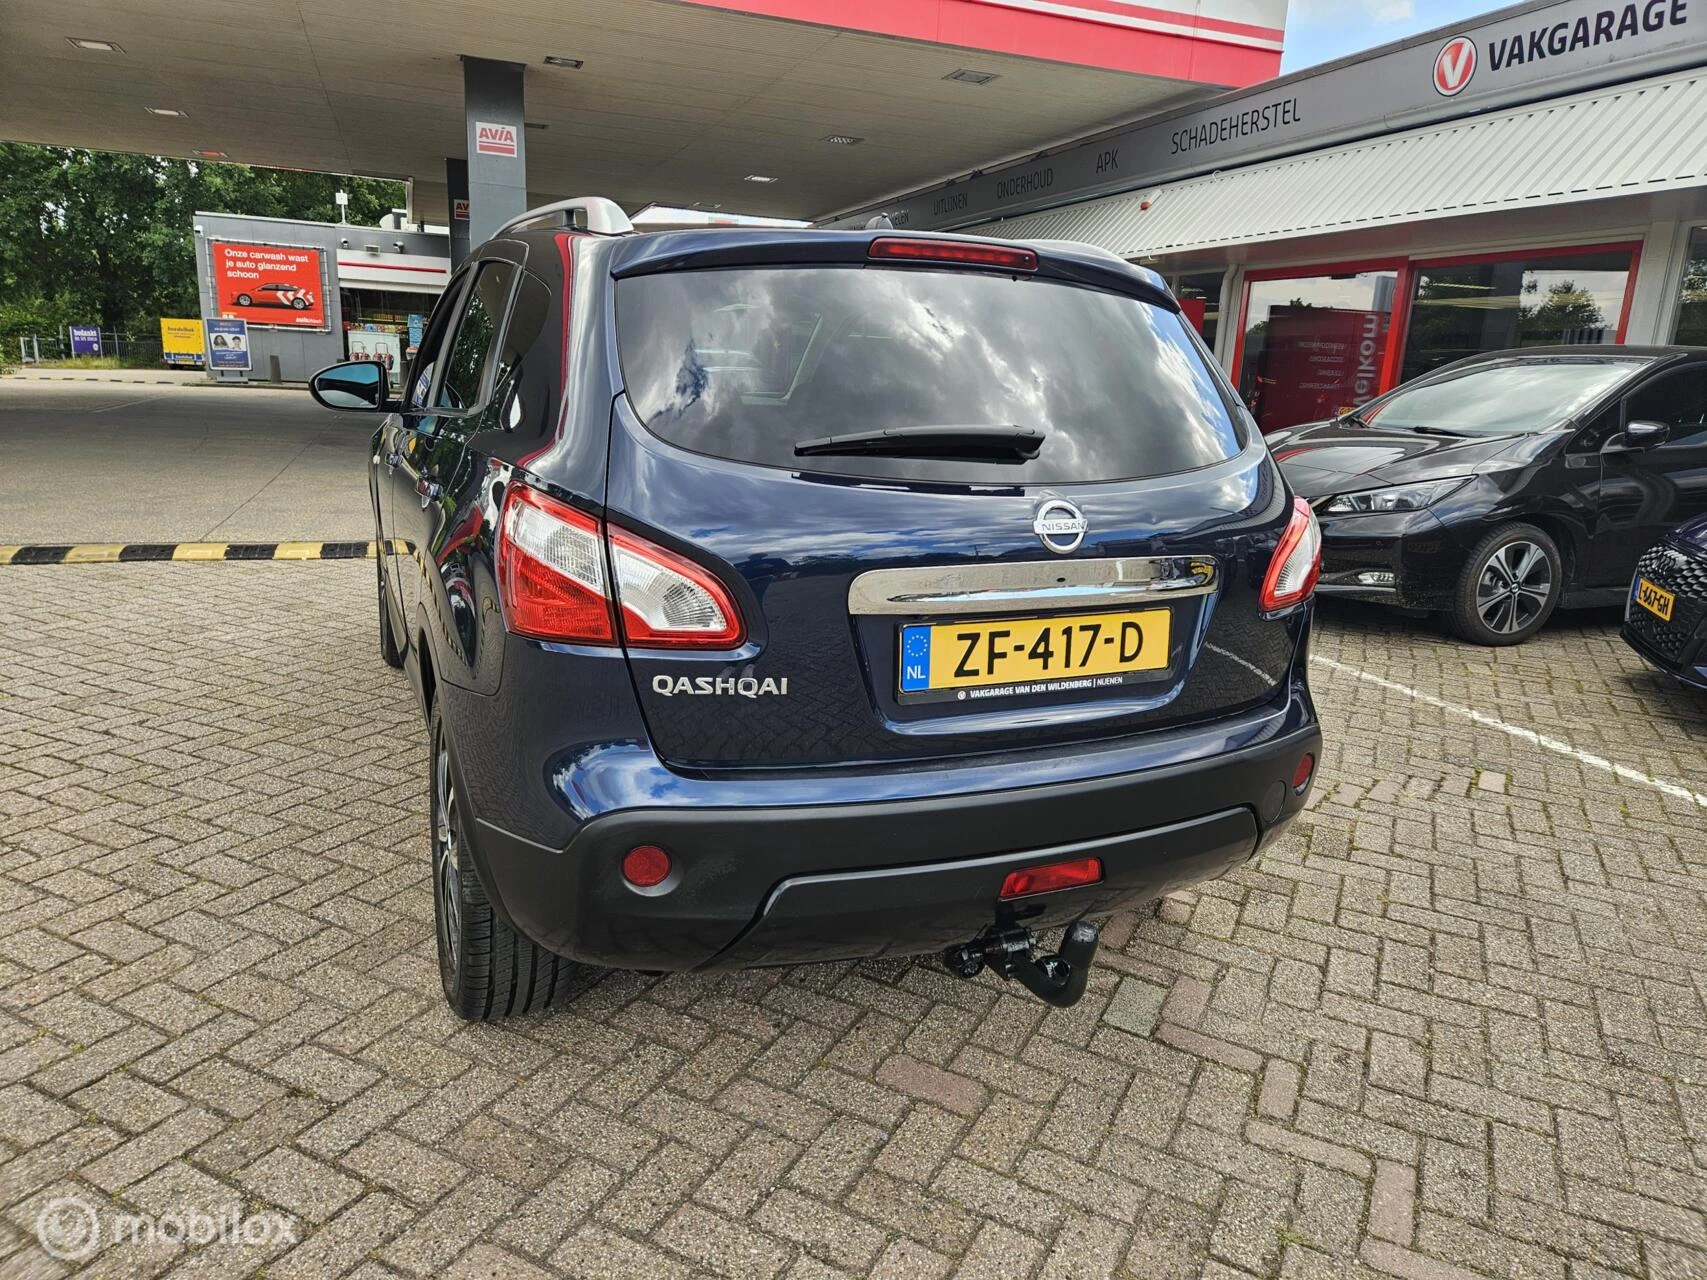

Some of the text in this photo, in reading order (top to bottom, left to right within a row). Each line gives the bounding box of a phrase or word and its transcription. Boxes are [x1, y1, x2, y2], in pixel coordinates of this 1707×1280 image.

[1488, 0, 1688, 72] VAKGARAGE
[1171, 98, 1301, 155] SCHADEHERSTEL
[1096, 150, 1119, 174] APK
[996, 168, 1054, 199] ONDERHOUD
[456, 203, 469, 211] AV
[224, 248, 309, 263] Onze carwash wast
[225, 259, 297, 272] je auto glanzend
[227, 270, 260, 279] schoon
[1041, 522, 1085, 531] NISSAN
[906, 621, 1144, 680] NL ZF-417-D
[652, 675, 788, 698] QASHQAI
[970, 687, 1014, 698] VAKGARAGE
[1015, 685, 1030, 694] VAN
[1031, 684, 1047, 693] DEN
[1047, 680, 1092, 691] WILDENBERG
